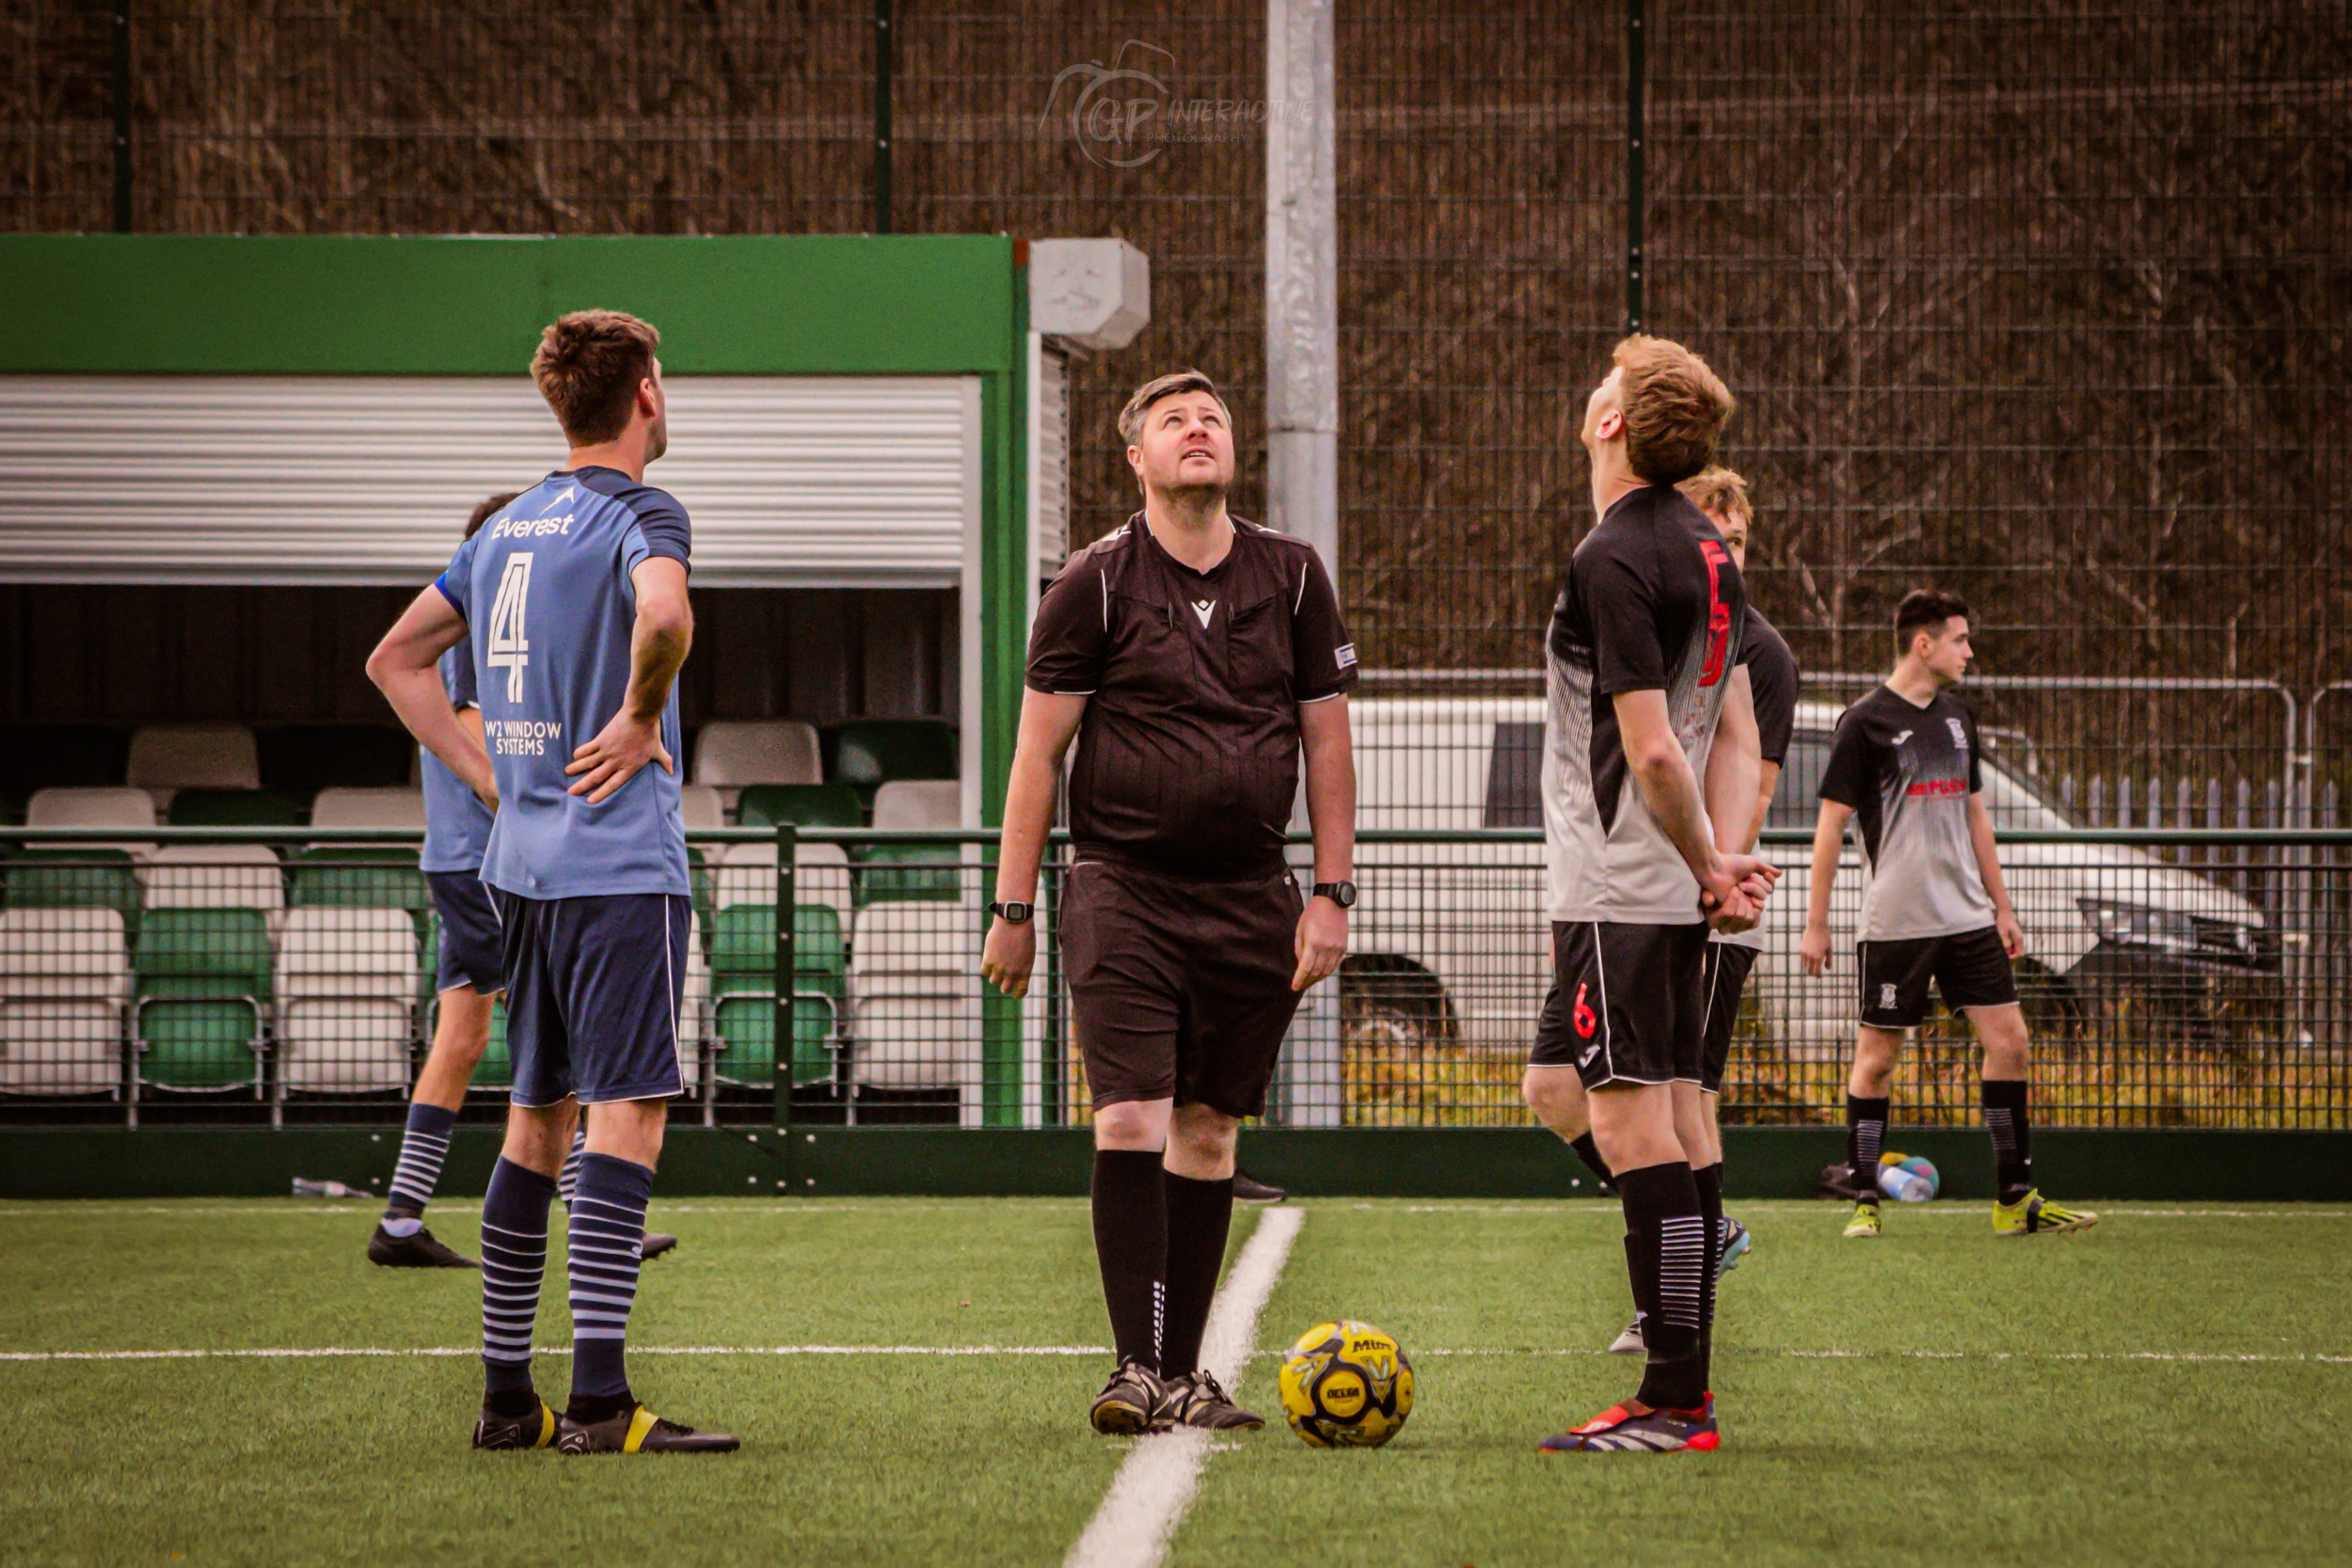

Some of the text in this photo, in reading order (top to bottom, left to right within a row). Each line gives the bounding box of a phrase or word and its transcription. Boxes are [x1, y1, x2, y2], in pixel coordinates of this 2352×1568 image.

[490, 514, 576, 541] Everest
[486, 551, 534, 704] 4
[484, 720, 563, 740] W2 WINDOW
[495, 737, 545, 756] SYSTEMS
[1573, 981, 1597, 1038] 6
